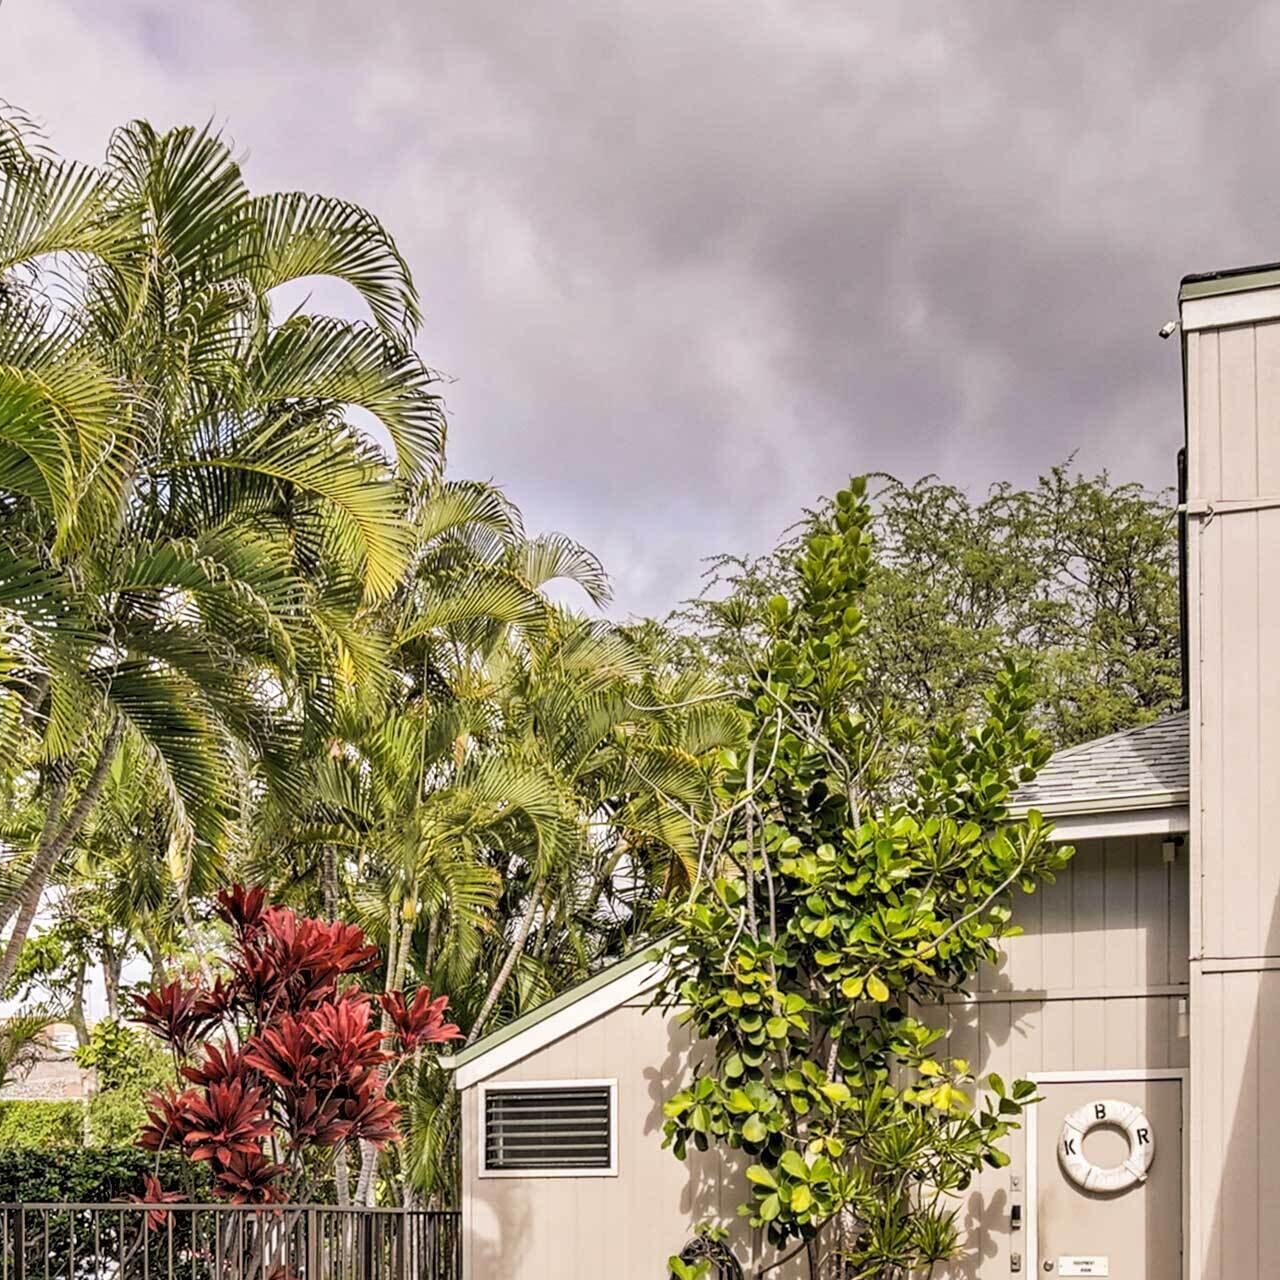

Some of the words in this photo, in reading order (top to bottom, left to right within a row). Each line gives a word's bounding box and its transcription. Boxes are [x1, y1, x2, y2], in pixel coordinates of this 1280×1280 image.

[1064, 1139, 1076, 1156] K
[1094, 1103, 1106, 1120] B
[1136, 1128, 1150, 1146] R
